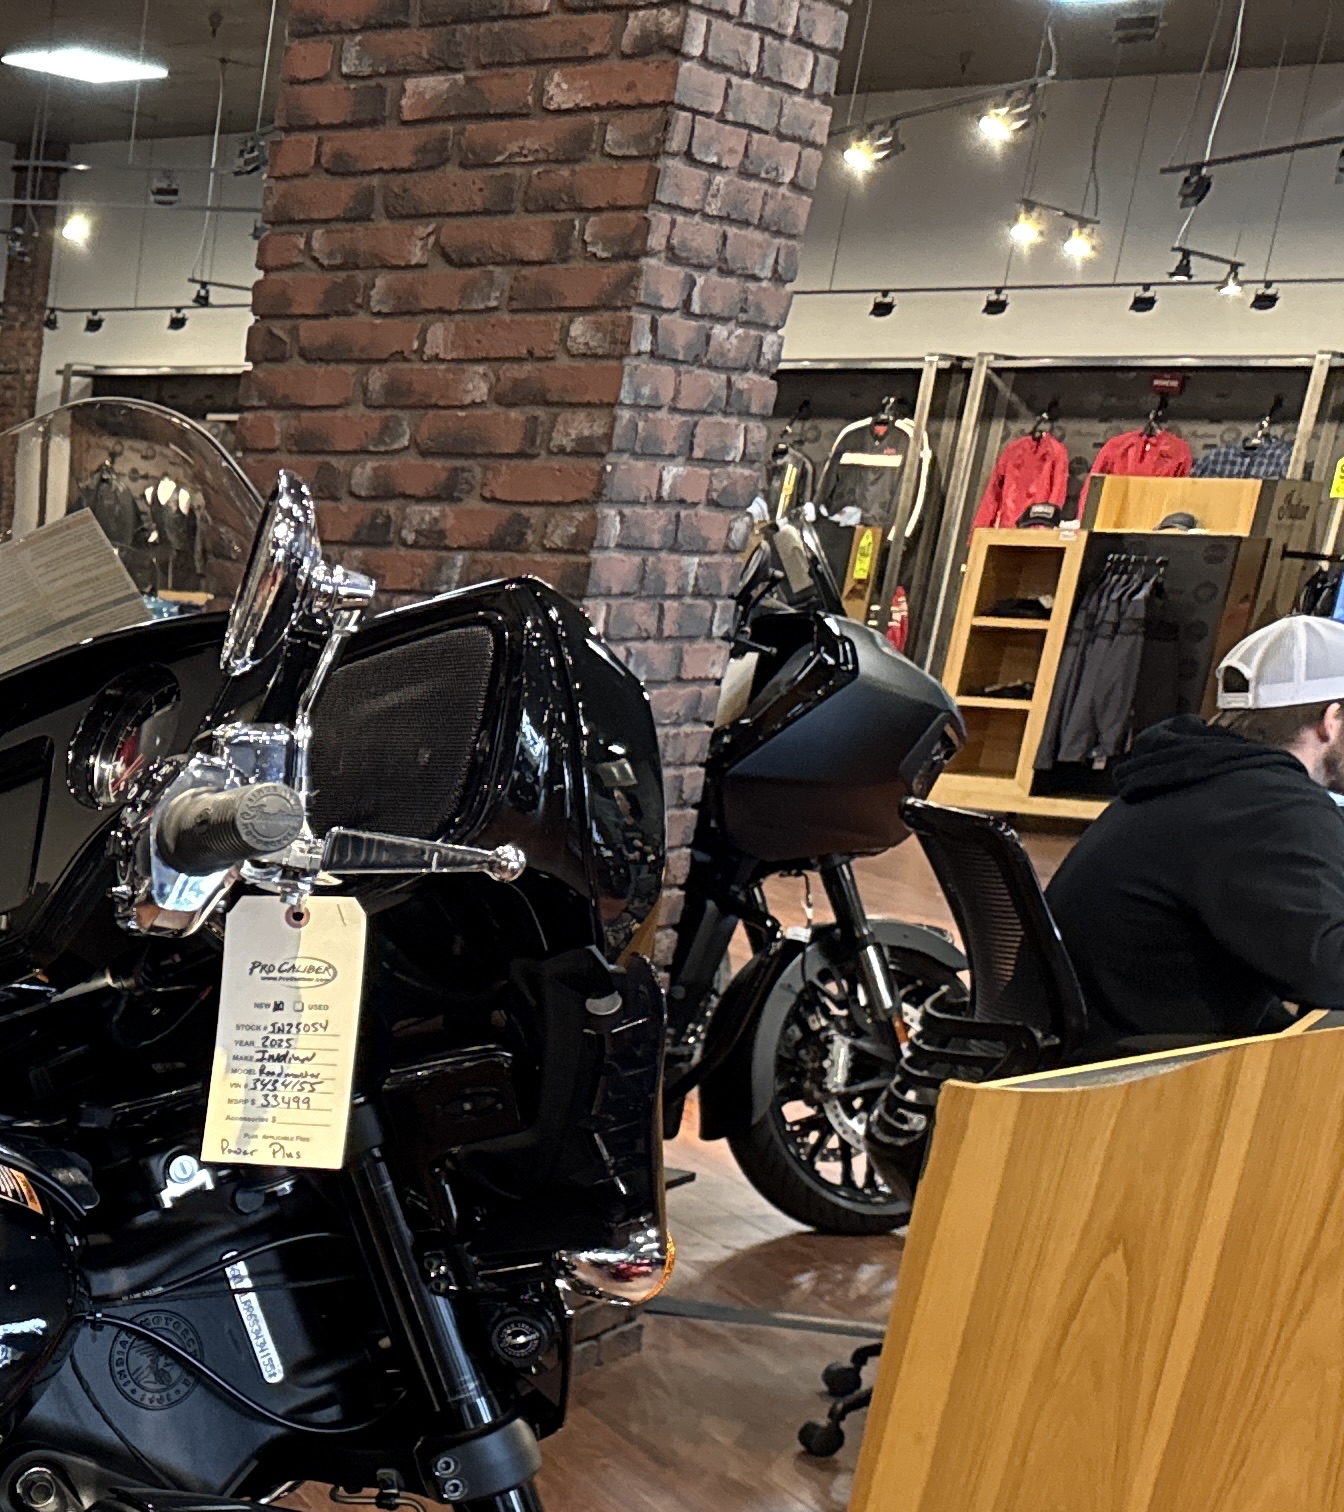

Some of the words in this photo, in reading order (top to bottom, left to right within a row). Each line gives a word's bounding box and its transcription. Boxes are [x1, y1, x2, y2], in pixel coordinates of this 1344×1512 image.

[249, 960, 274, 976] PRO
[277, 961, 332, 976] CALIBER
[236, 1023, 261, 1031] STOCK
[261, 1035, 294, 1049] 2025
[232, 1054, 254, 1062] MAKE
[230, 1067, 257, 1075] MODEL
[249, 1078, 325, 1093] 3434155
[261, 1093, 311, 1109] 33499
[269, 1141, 302, 1160] Plus
